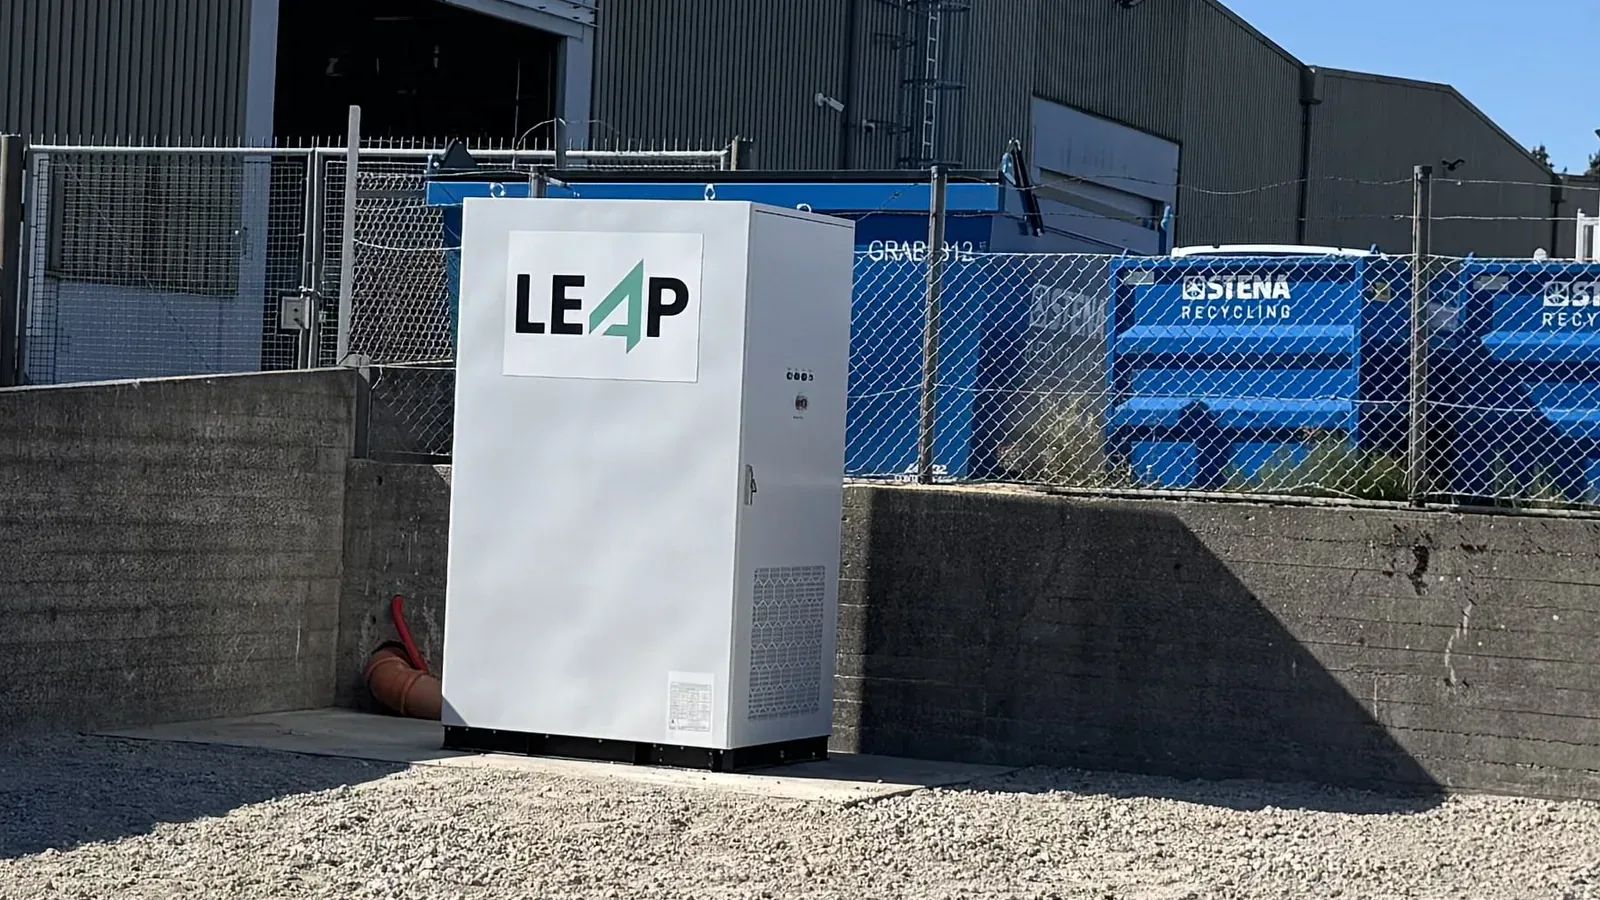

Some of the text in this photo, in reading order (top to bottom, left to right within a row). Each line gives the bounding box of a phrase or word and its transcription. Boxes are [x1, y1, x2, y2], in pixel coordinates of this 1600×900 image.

[1207, 274, 1291, 300] STENA
[515, 259, 690, 354] LEAP
[1181, 304, 1291, 320] RECYCLING
[1542, 312, 1598, 327] RECY
